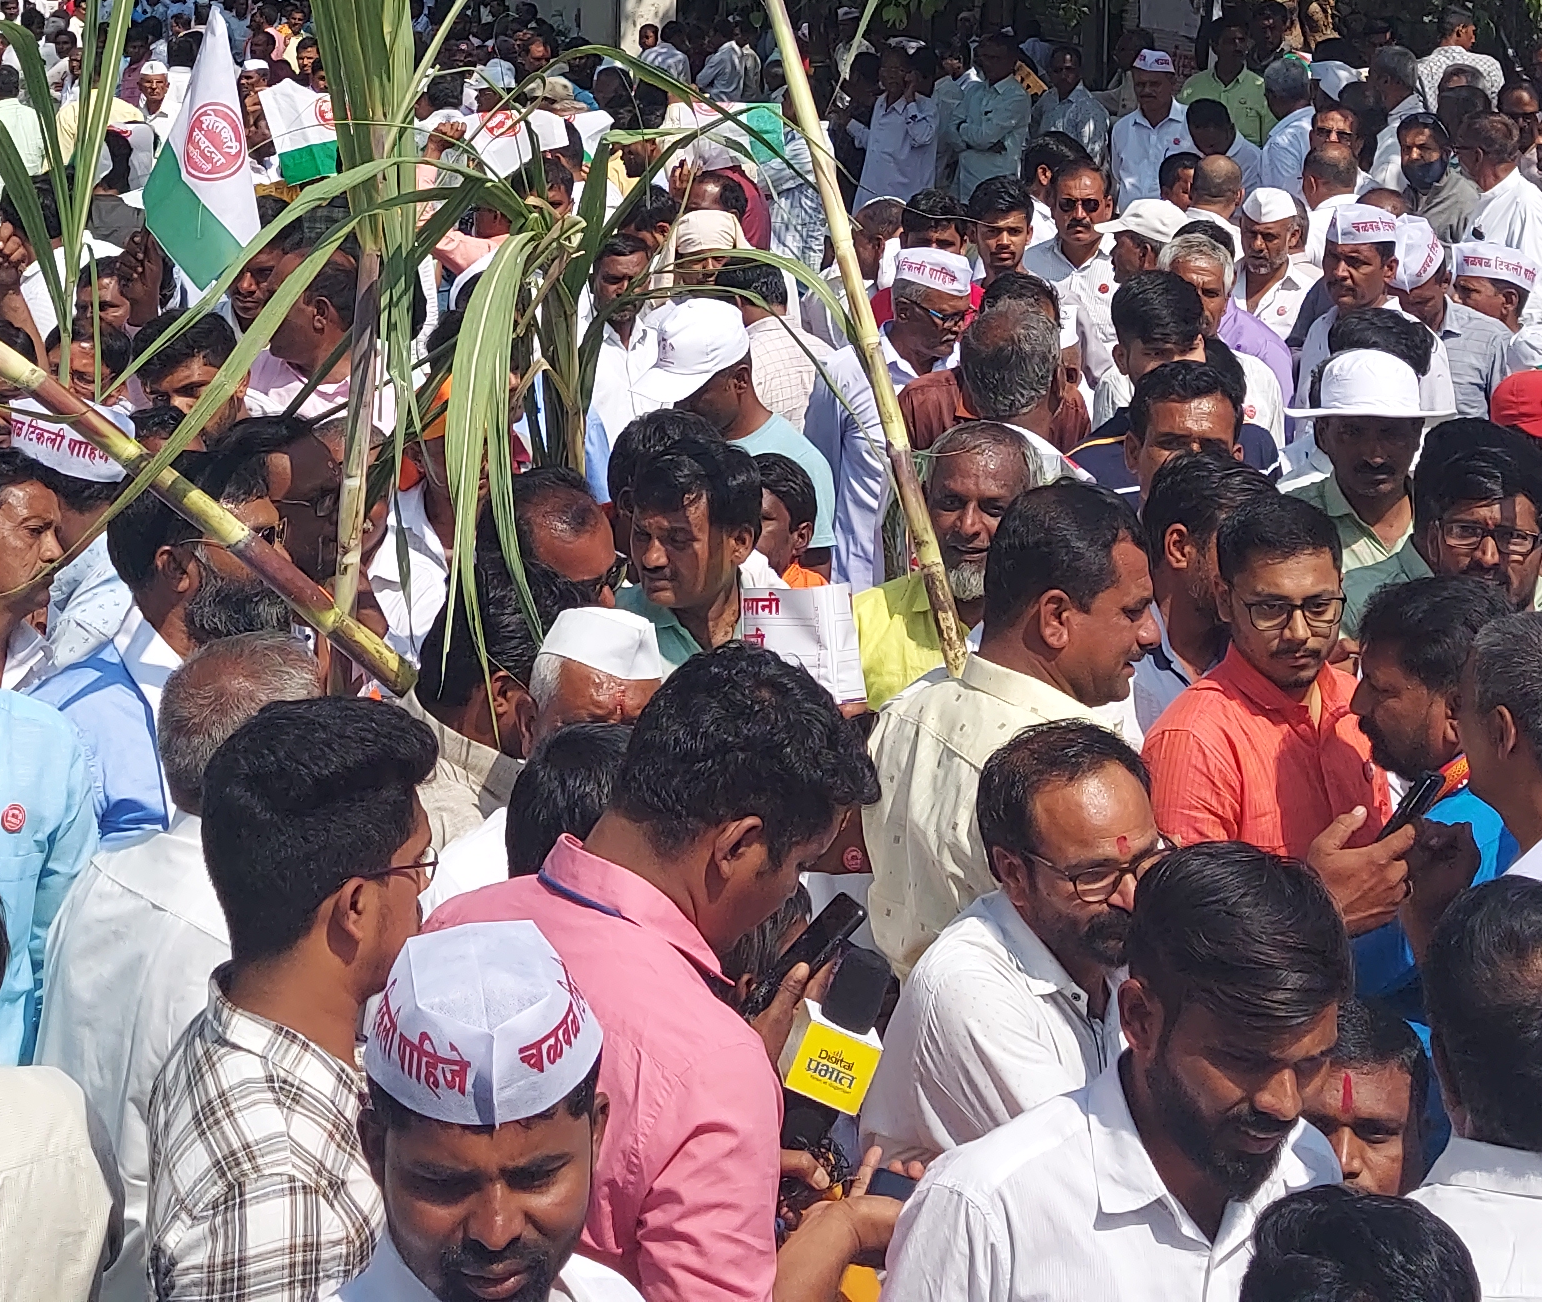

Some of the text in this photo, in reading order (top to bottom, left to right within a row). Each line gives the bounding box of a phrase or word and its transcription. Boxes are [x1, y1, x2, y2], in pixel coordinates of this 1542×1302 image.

[192, 127, 226, 167] संघटना
[200, 110, 240, 155] शेतकरी
[1463, 255, 1492, 268] चळवळ
[1494, 255, 1523, 276] टिकली
[24, 418, 66, 452] टिकली
[517, 1000, 582, 1074] चळवळ
[397, 1031, 472, 1101] पाहिजे
[804, 1056, 858, 1090] प्रभात
